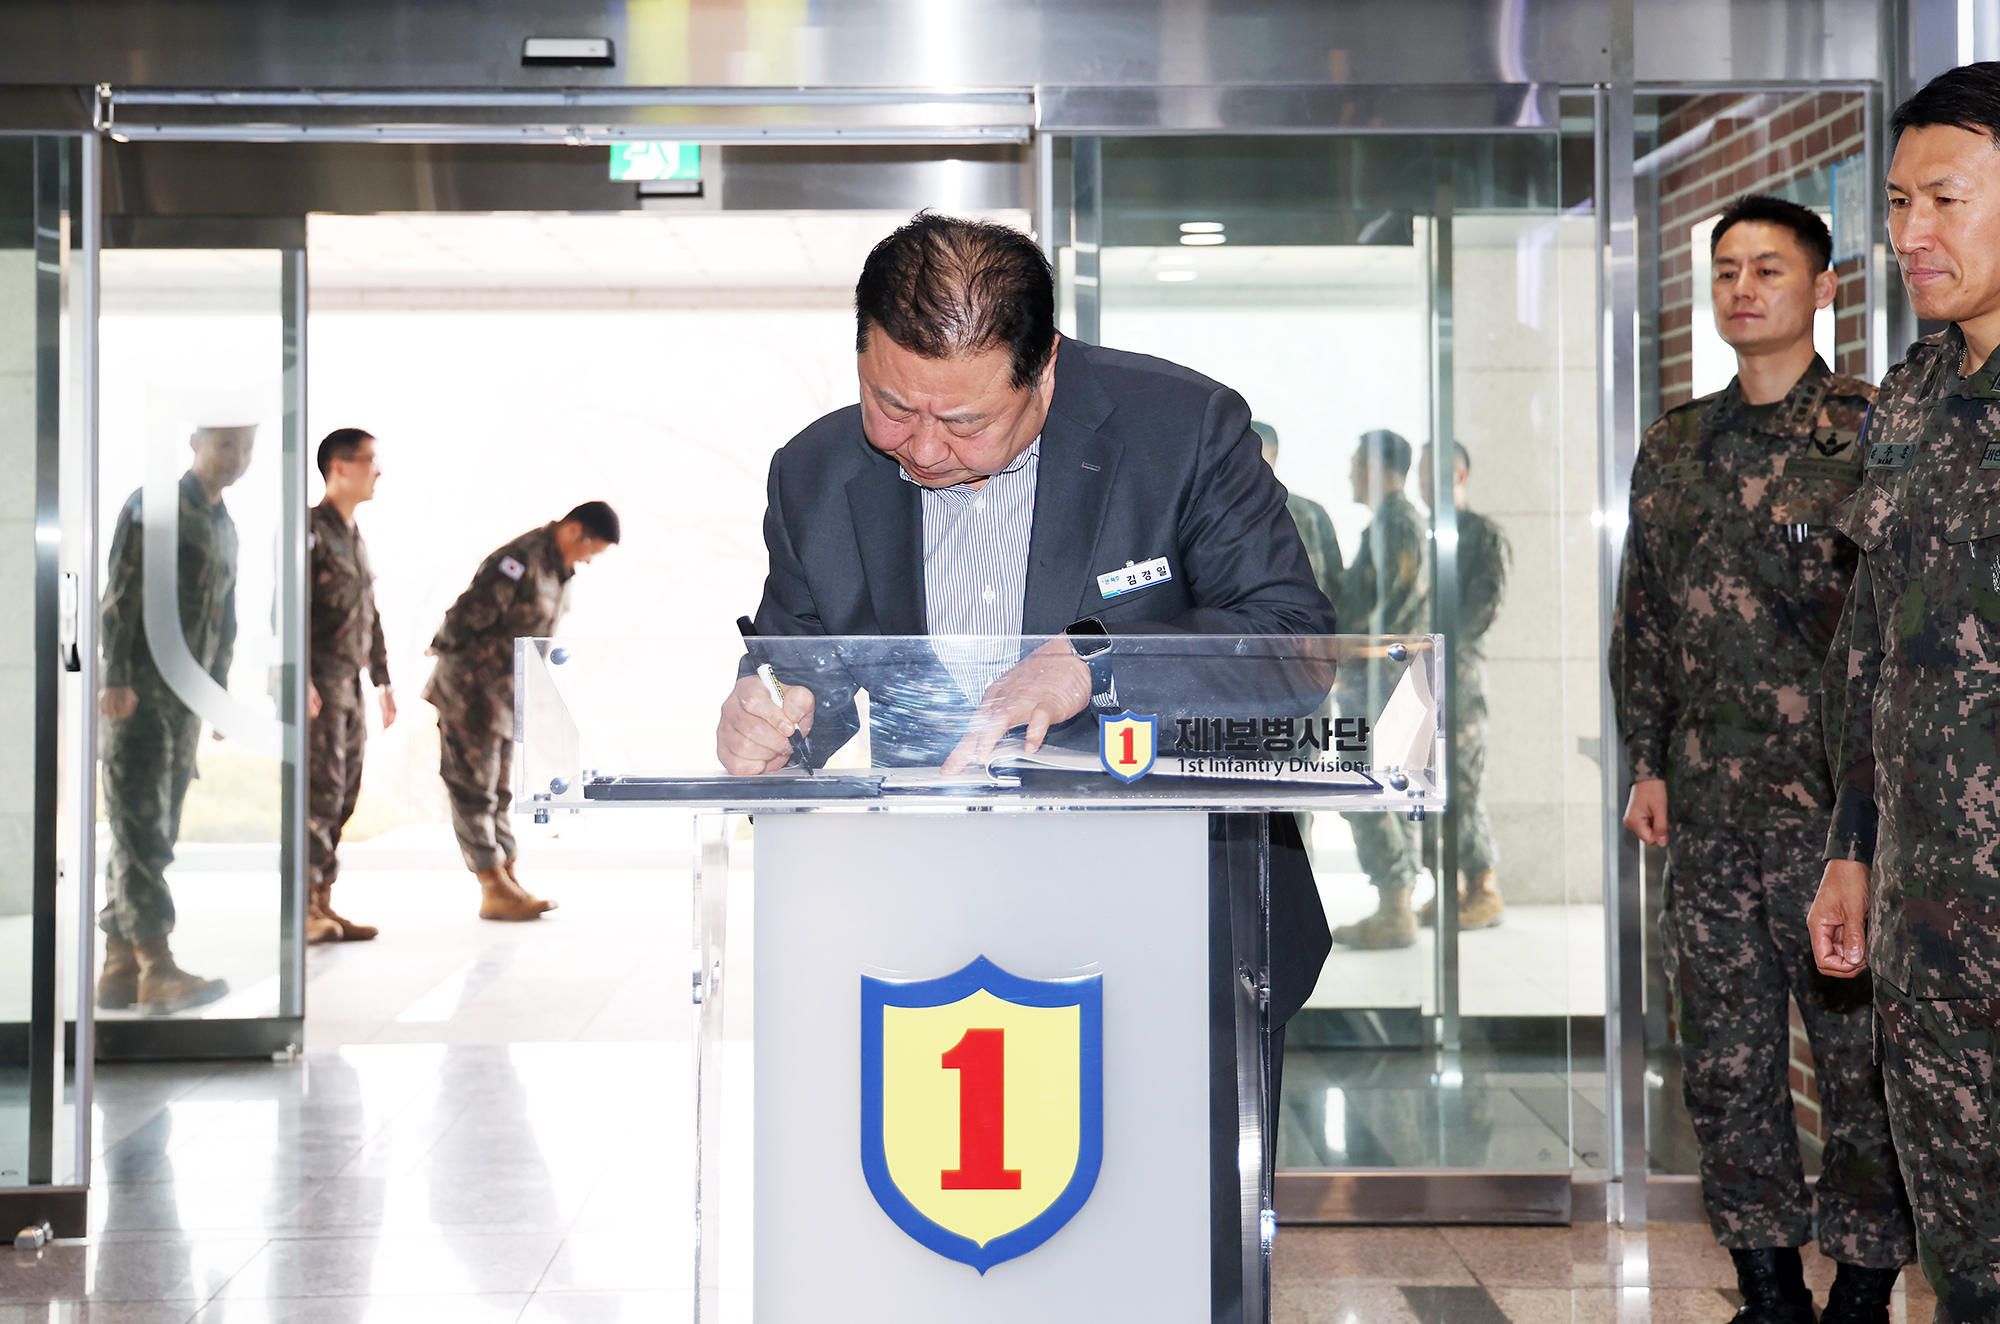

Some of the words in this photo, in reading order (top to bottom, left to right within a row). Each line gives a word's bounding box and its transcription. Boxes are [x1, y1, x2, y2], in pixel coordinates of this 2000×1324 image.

[1118, 727, 1138, 764] 1
[1174, 717, 1370, 752] 제1보병사단
[1178, 757, 1204, 773] 1st
[1209, 757, 1284, 777] Infantry
[1289, 757, 1365, 773] Division
[940, 1027, 1022, 1190] 1
